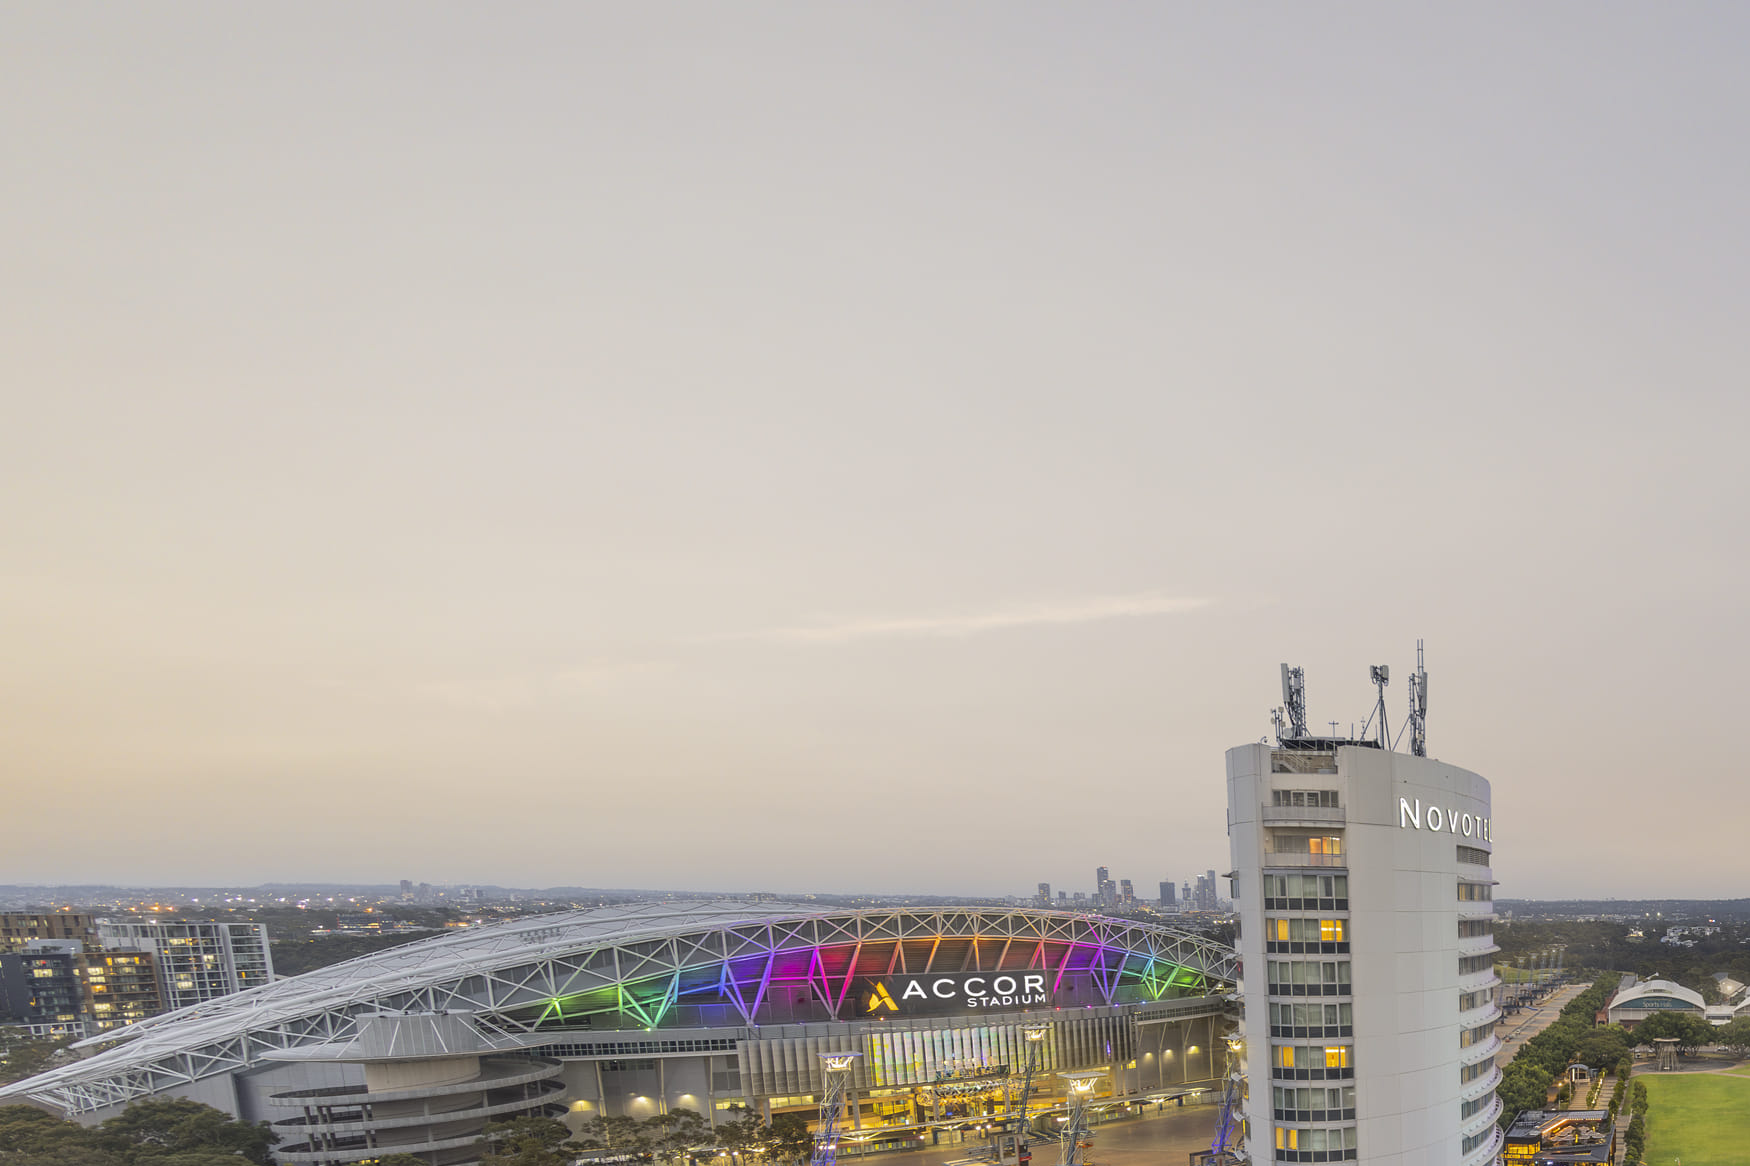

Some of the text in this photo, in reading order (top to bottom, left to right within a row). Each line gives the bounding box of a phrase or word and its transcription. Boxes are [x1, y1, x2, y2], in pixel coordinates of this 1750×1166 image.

[1400, 797, 1493, 843] NOVOTEL
[902, 975, 1045, 1000] ACCOR
[967, 994, 1046, 1008] STADIUM
